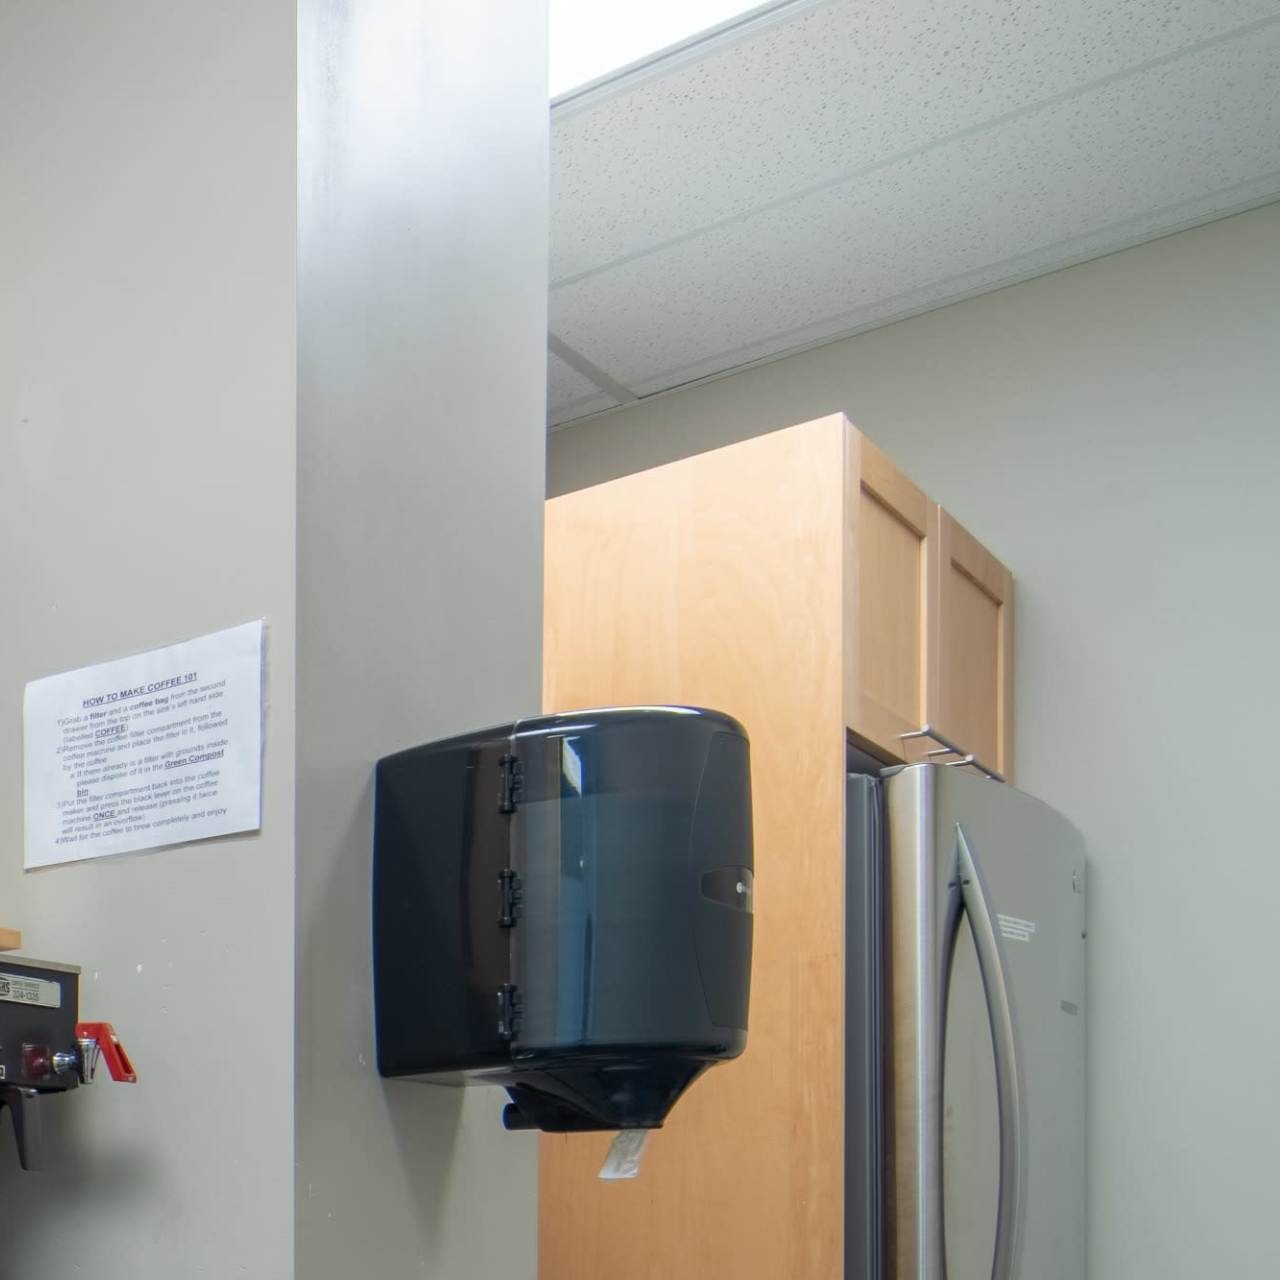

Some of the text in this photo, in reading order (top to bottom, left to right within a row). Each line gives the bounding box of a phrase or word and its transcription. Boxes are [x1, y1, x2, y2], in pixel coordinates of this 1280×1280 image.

[83, 672, 197, 708] HOW TO MAKE COFFEE 101
[90, 712, 106, 720] filter
[109, 706, 121, 716] and
[130, 701, 153, 710] coffee
[170, 692, 185, 701] from
[187, 688, 198, 696] the
[200, 680, 225, 692] second
[89, 720, 105, 728] from
[107, 734, 128, 744] coffee
[146, 718, 191, 735] compartment
[192, 714, 208, 724] from
[210, 711, 222, 721] the
[63, 753, 85, 761] coffee
[87, 746, 116, 757] machine
[118, 742, 130, 750] and
[132, 739, 151, 747] place
[198, 720, 228, 731] followed
[86, 758, 107, 766] coffee
[102, 762, 127, 772] already
[176, 745, 204, 758] grounds
[165, 758, 187, 769] Green
[188, 750, 224, 764] Compost
[86, 804, 99, 812] and
[196, 780, 218, 790] coffee
[105, 784, 150, 799] compartment
[198, 770, 220, 780] coffee
[93, 810, 115, 820] ONCE
[118, 807, 130, 815] and
[103, 828, 123, 836] coffee
[153, 816, 189, 827] completely
